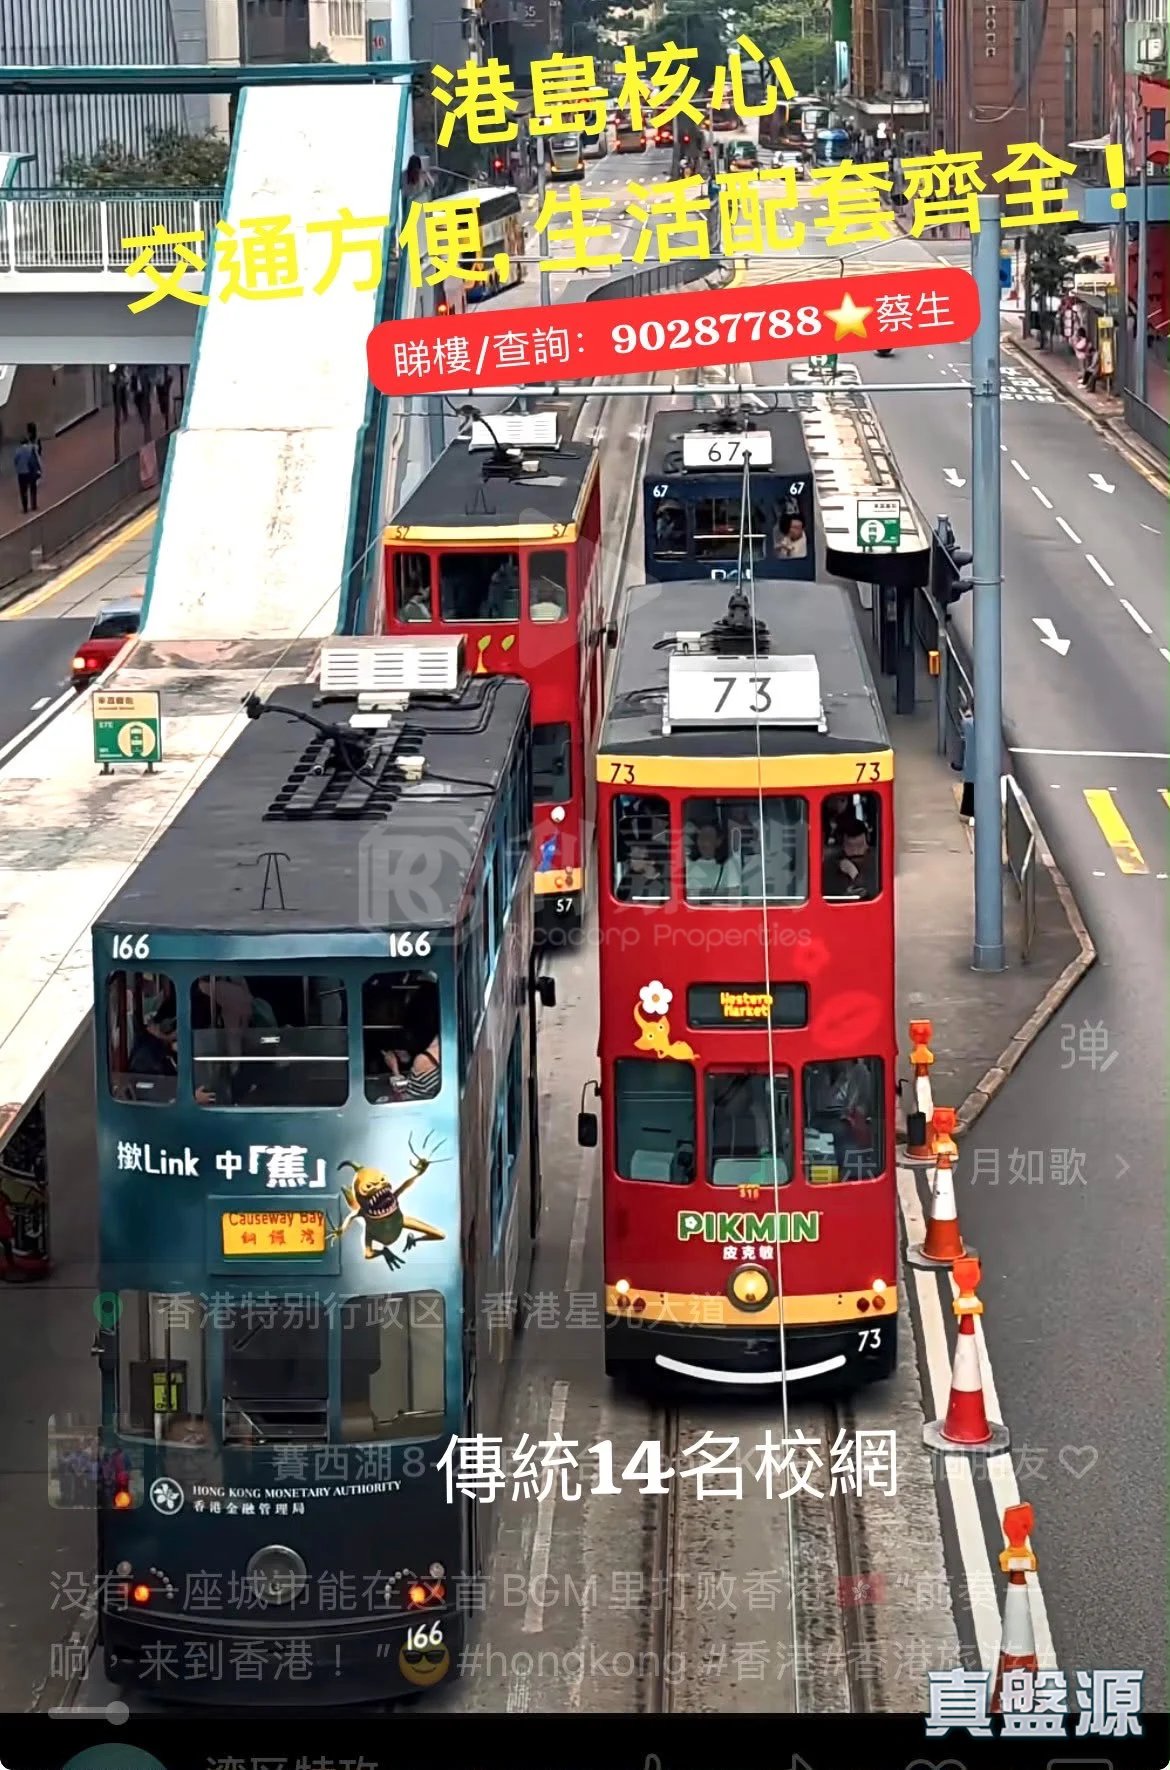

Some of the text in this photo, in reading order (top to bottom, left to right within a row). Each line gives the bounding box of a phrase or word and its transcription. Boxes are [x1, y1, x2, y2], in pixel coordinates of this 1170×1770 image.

[708, 441, 741, 463] 67
[652, 481, 805, 498] 67 67
[396, 522, 568, 540] 57 57
[713, 677, 772, 713] 73
[610, 762, 881, 785] 73 73
[556, 897, 573, 912] 57
[112, 930, 431, 960] 166 166
[228, 1211, 324, 1227] Causeway Bay
[678, 1211, 820, 1243] PIKMIN
[722, 1245, 774, 1260] 皮克敏
[858, 1328, 881, 1352] 73
[192, 1480, 402, 1499] HONG KONG MONETARY AUTHORITY
[193, 1500, 306, 1516] 香港金融管理局
[406, 1620, 444, 1650] 166
